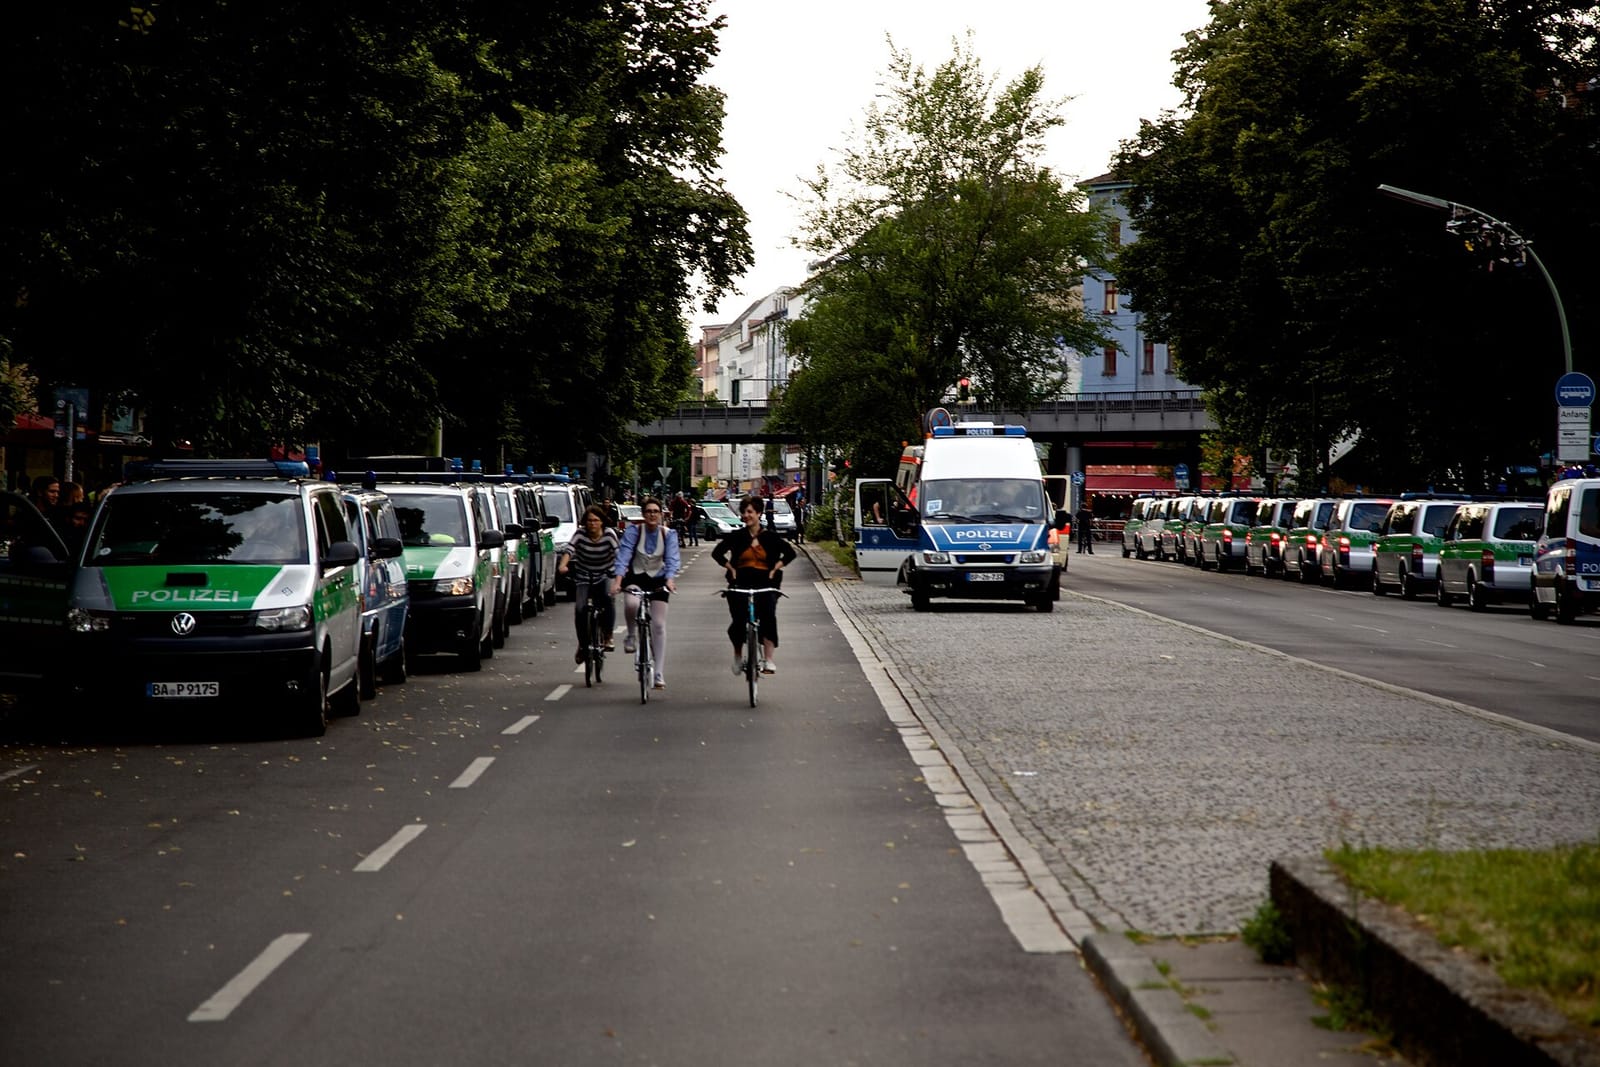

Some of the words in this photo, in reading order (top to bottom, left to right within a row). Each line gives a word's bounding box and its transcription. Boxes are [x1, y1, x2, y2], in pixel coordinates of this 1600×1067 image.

[1560, 410, 1589, 420] Anfang
[966, 428, 994, 437] POLIZEI
[955, 530, 1014, 539] POLIZEI
[131, 589, 239, 603] POLIZEI
[152, 683, 169, 696] BA
